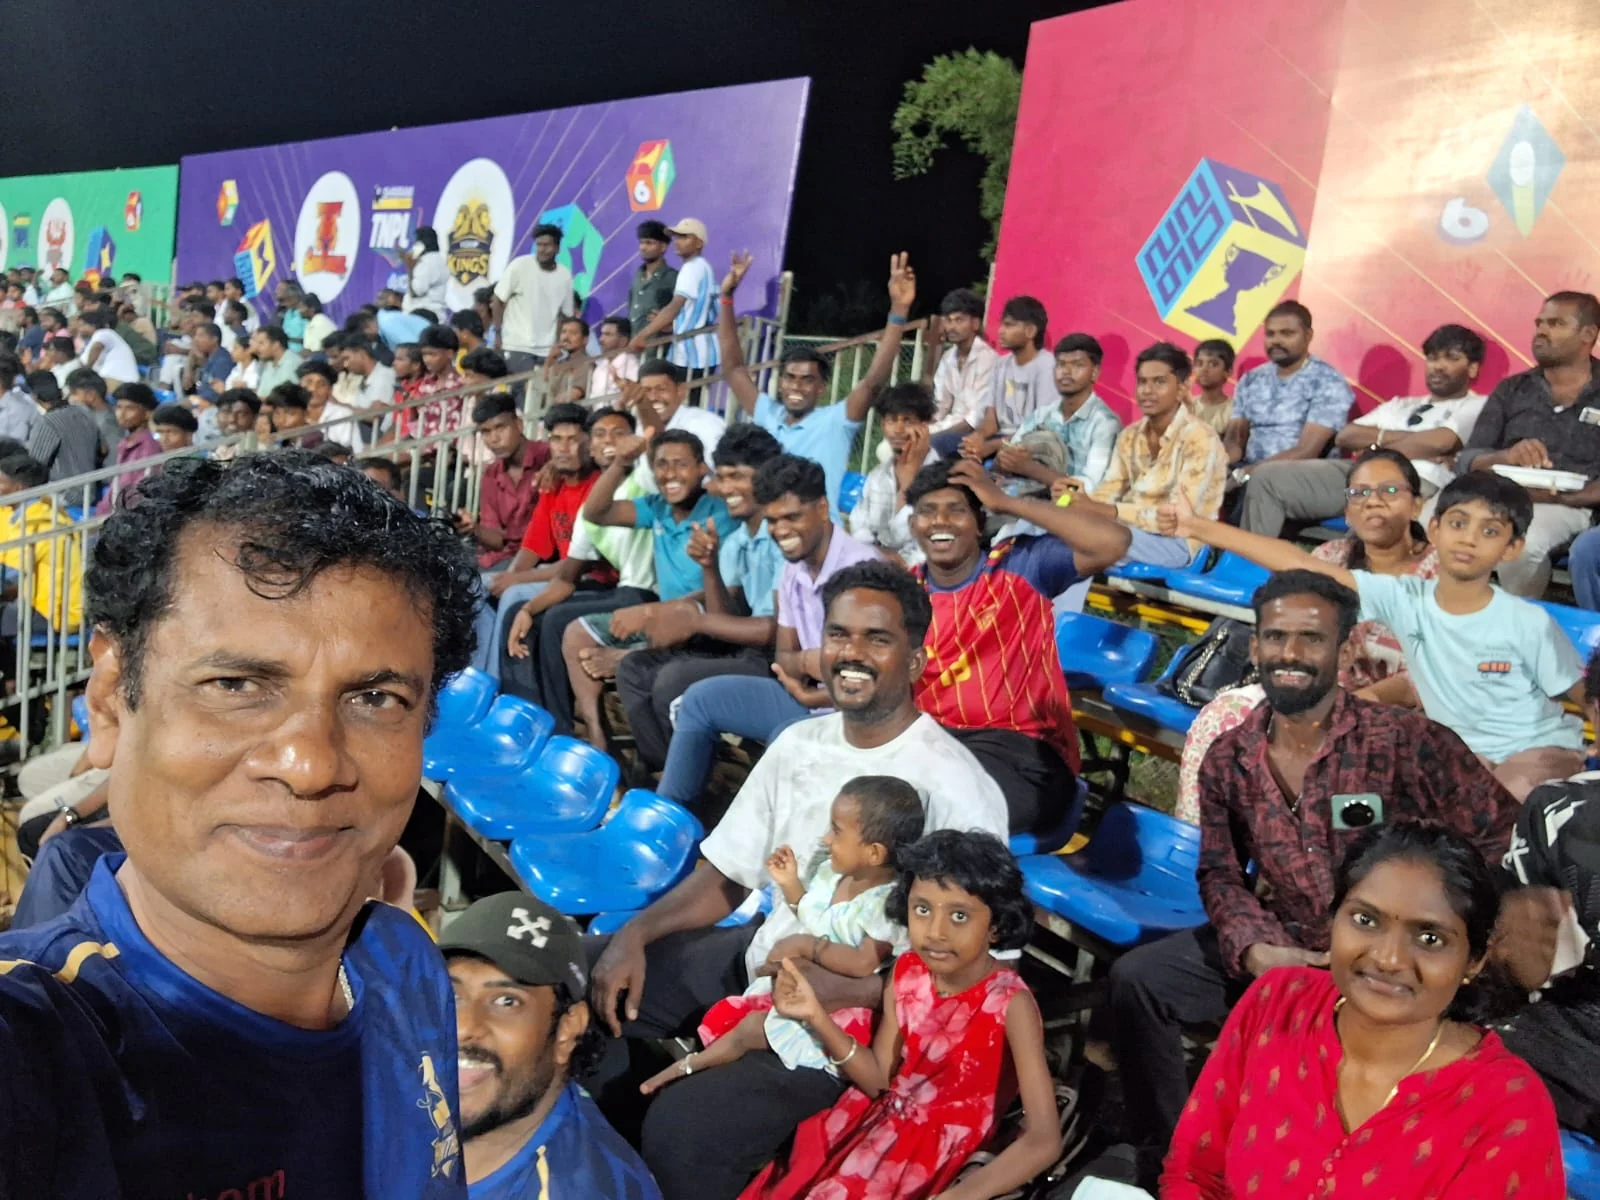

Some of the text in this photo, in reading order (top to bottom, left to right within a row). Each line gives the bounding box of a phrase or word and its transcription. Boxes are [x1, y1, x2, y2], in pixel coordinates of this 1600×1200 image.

[369, 211, 411, 249] TNPL
[1439, 197, 1489, 241] 6
[447, 253, 490, 276] KINGS
